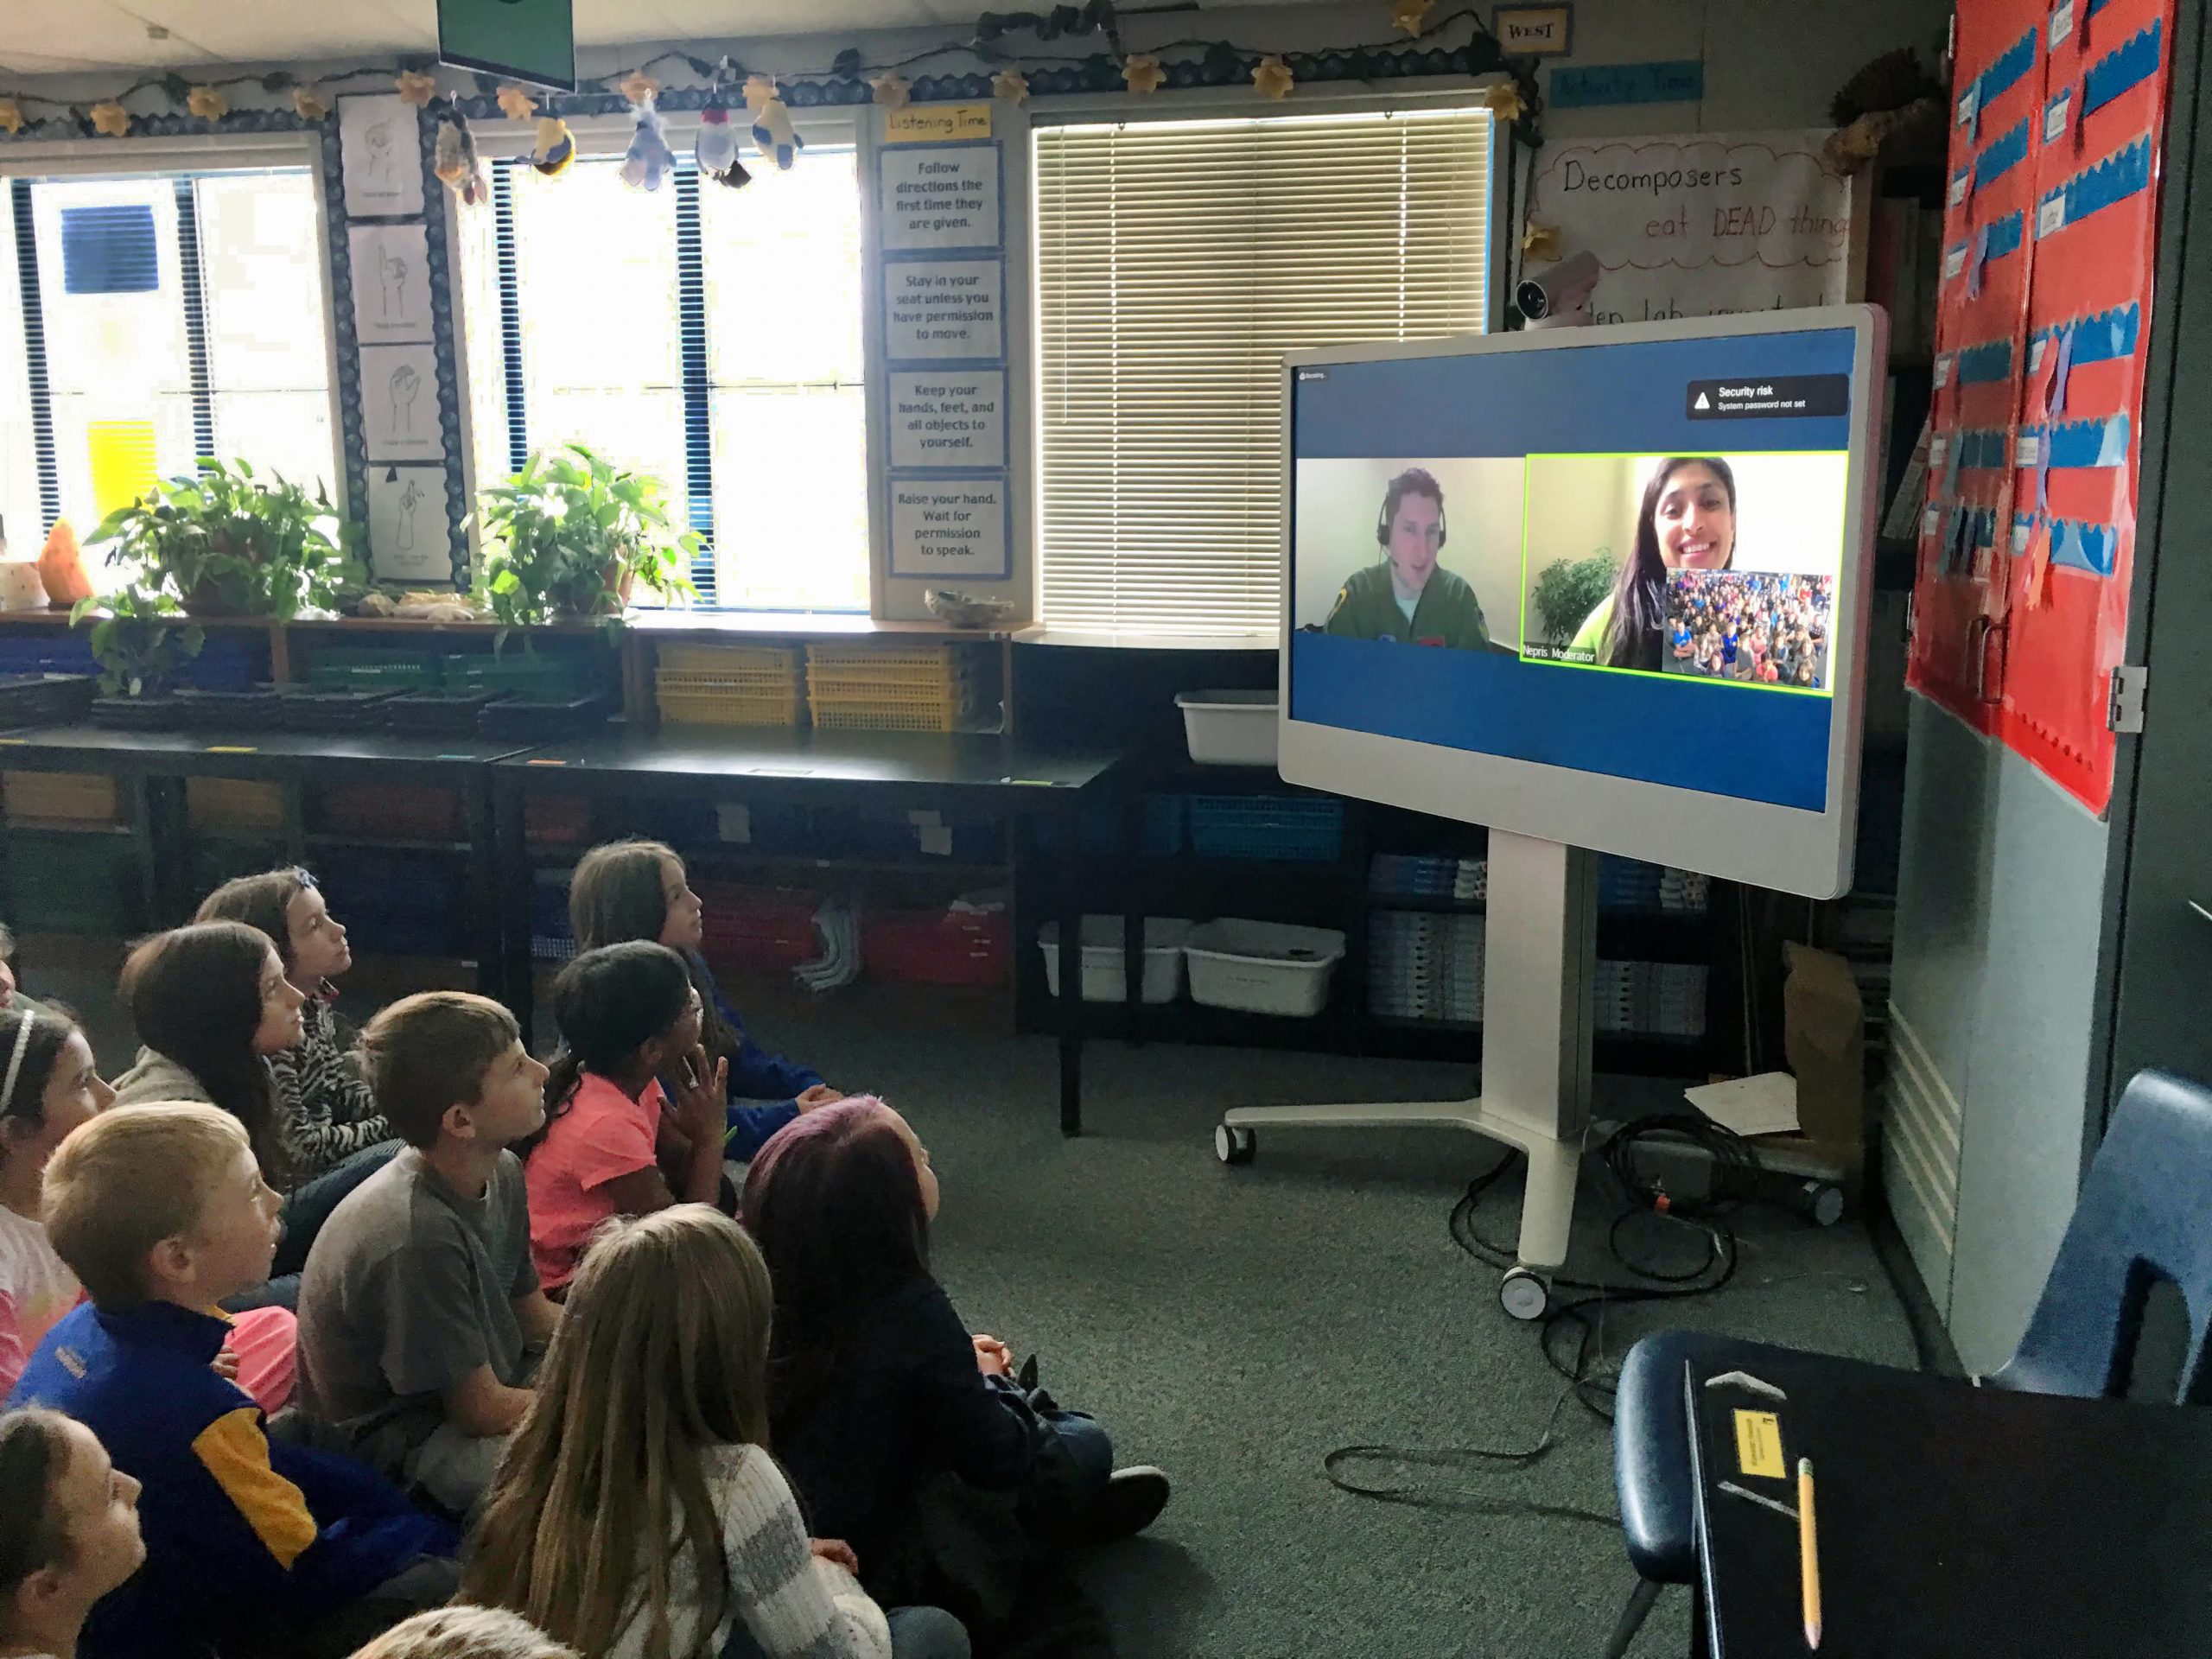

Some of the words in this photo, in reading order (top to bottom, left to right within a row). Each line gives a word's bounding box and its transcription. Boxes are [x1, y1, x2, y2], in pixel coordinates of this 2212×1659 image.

[1509, 23, 1554, 39] WEST
[889, 114, 953, 133] Listening
[957, 110, 988, 126] Time
[918, 162, 959, 174] Follow
[1563, 161, 1742, 195] Decomposers
[896, 181, 958, 194] directions
[963, 180, 982, 191] the
[897, 200, 920, 211] first
[925, 200, 950, 210] time
[956, 198, 982, 211] they
[909, 219, 930, 229] are
[933, 217, 970, 229] given.
[1645, 206, 1689, 238] eat
[1712, 207, 1777, 237] DEAD
[906, 276, 931, 287] Stay
[936, 276, 946, 285] in
[950, 276, 980, 287] your
[896, 295, 922, 304] seat
[925, 293, 963, 303] unless
[967, 294, 988, 305] you
[893, 313, 923, 322] have
[926, 311, 993, 323] permission
[917, 329, 928, 340] to
[933, 329, 969, 339] move.
[915, 385, 945, 397] Keep
[949, 386, 977, 397] your
[1719, 386, 1755, 397] Security
[1757, 385, 1773, 395] risk
[899, 404, 937, 415] hands,
[941, 404, 969, 414] feet,
[972, 403, 994, 412] and
[1718, 402, 1743, 410] System
[1745, 401, 1778, 410] password
[908, 421, 922, 429] all
[925, 420, 969, 432] objects
[973, 421, 985, 429] to
[919, 437, 973, 449] yourself.
[899, 494, 928, 505] Raise
[931, 494, 960, 505] your
[963, 494, 996, 504] hand.
[924, 512, 950, 521] Wait
[954, 511, 971, 521] for
[915, 527, 980, 540] permission
[921, 545, 933, 555] to
[937, 544, 974, 556] speak.
[1523, 645, 1548, 658] Nepris
[1552, 648, 1595, 662] Moderator
